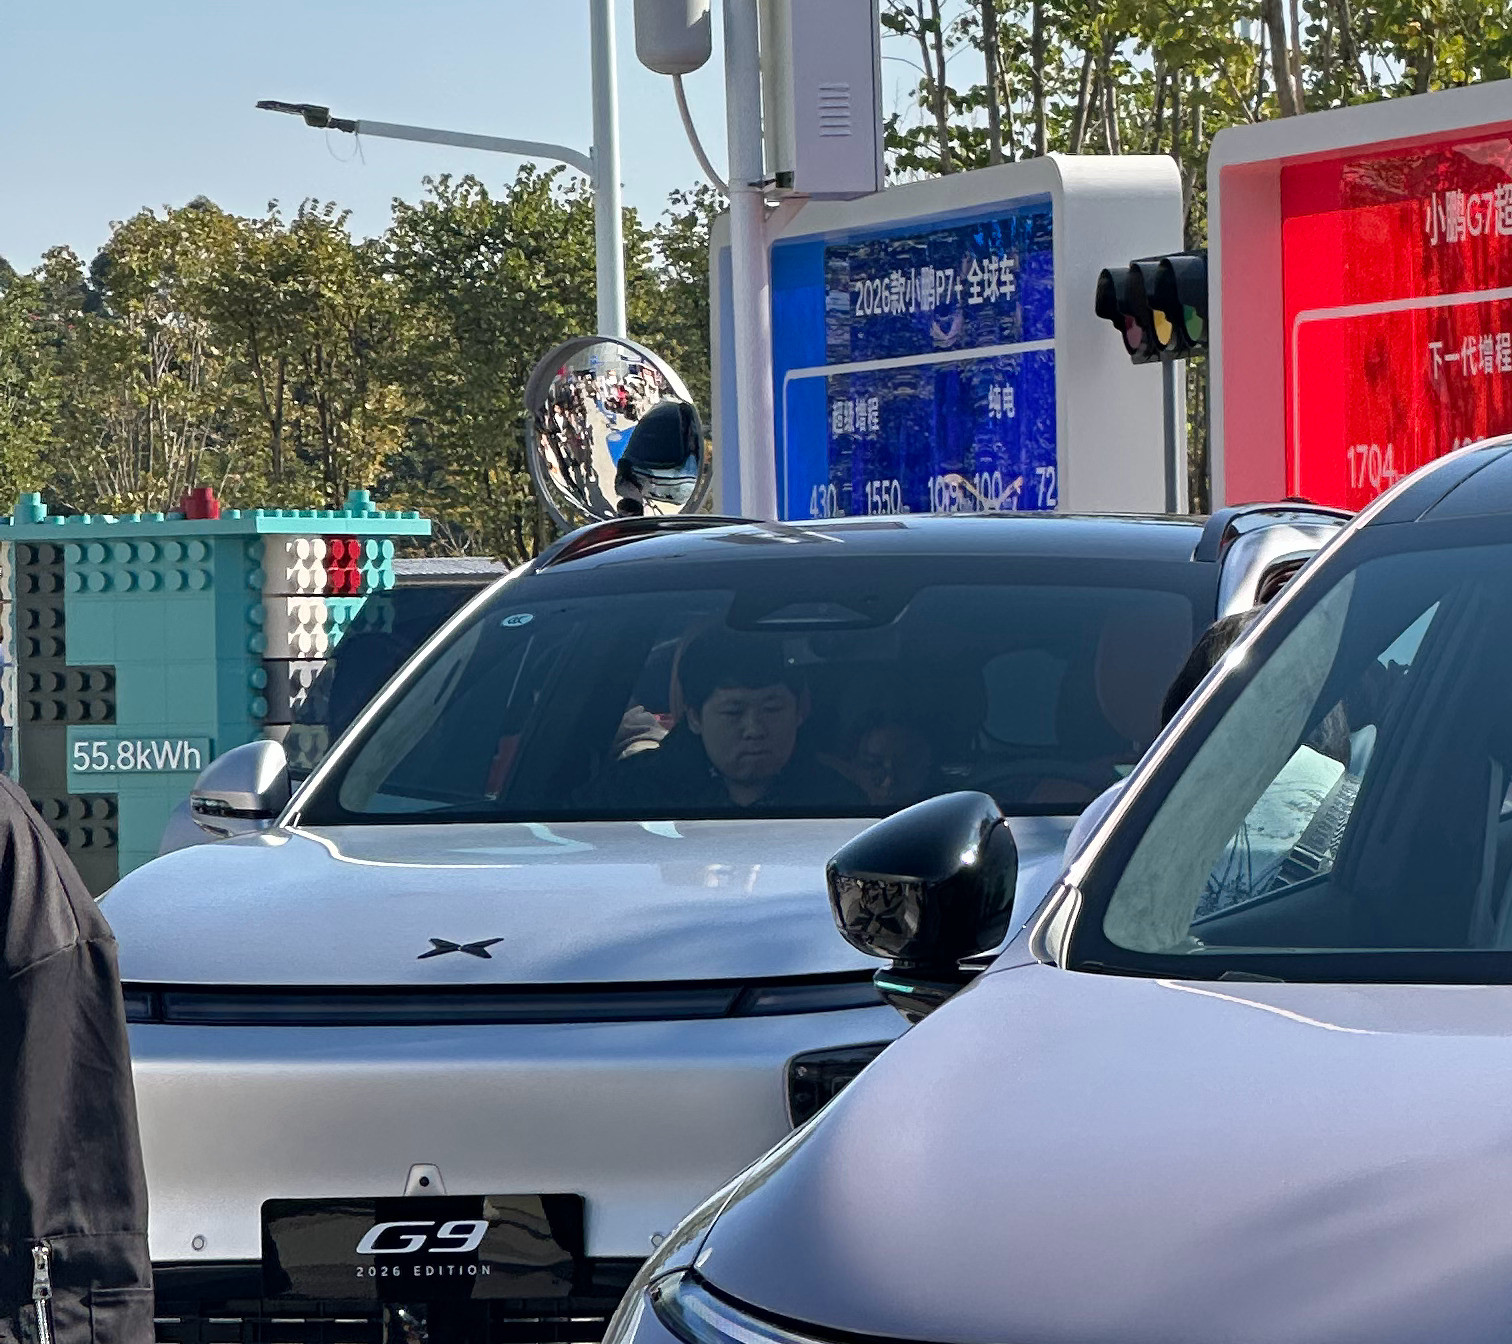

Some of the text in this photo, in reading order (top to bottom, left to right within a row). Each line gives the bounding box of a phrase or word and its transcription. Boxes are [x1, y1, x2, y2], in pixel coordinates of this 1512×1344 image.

[1428, 332, 1512, 380] 下一代增程
[73, 740, 201, 771] 55.8kWh
[356, 1220, 490, 1254] G9
[356, 1264, 491, 1277] 2026 EDITION
